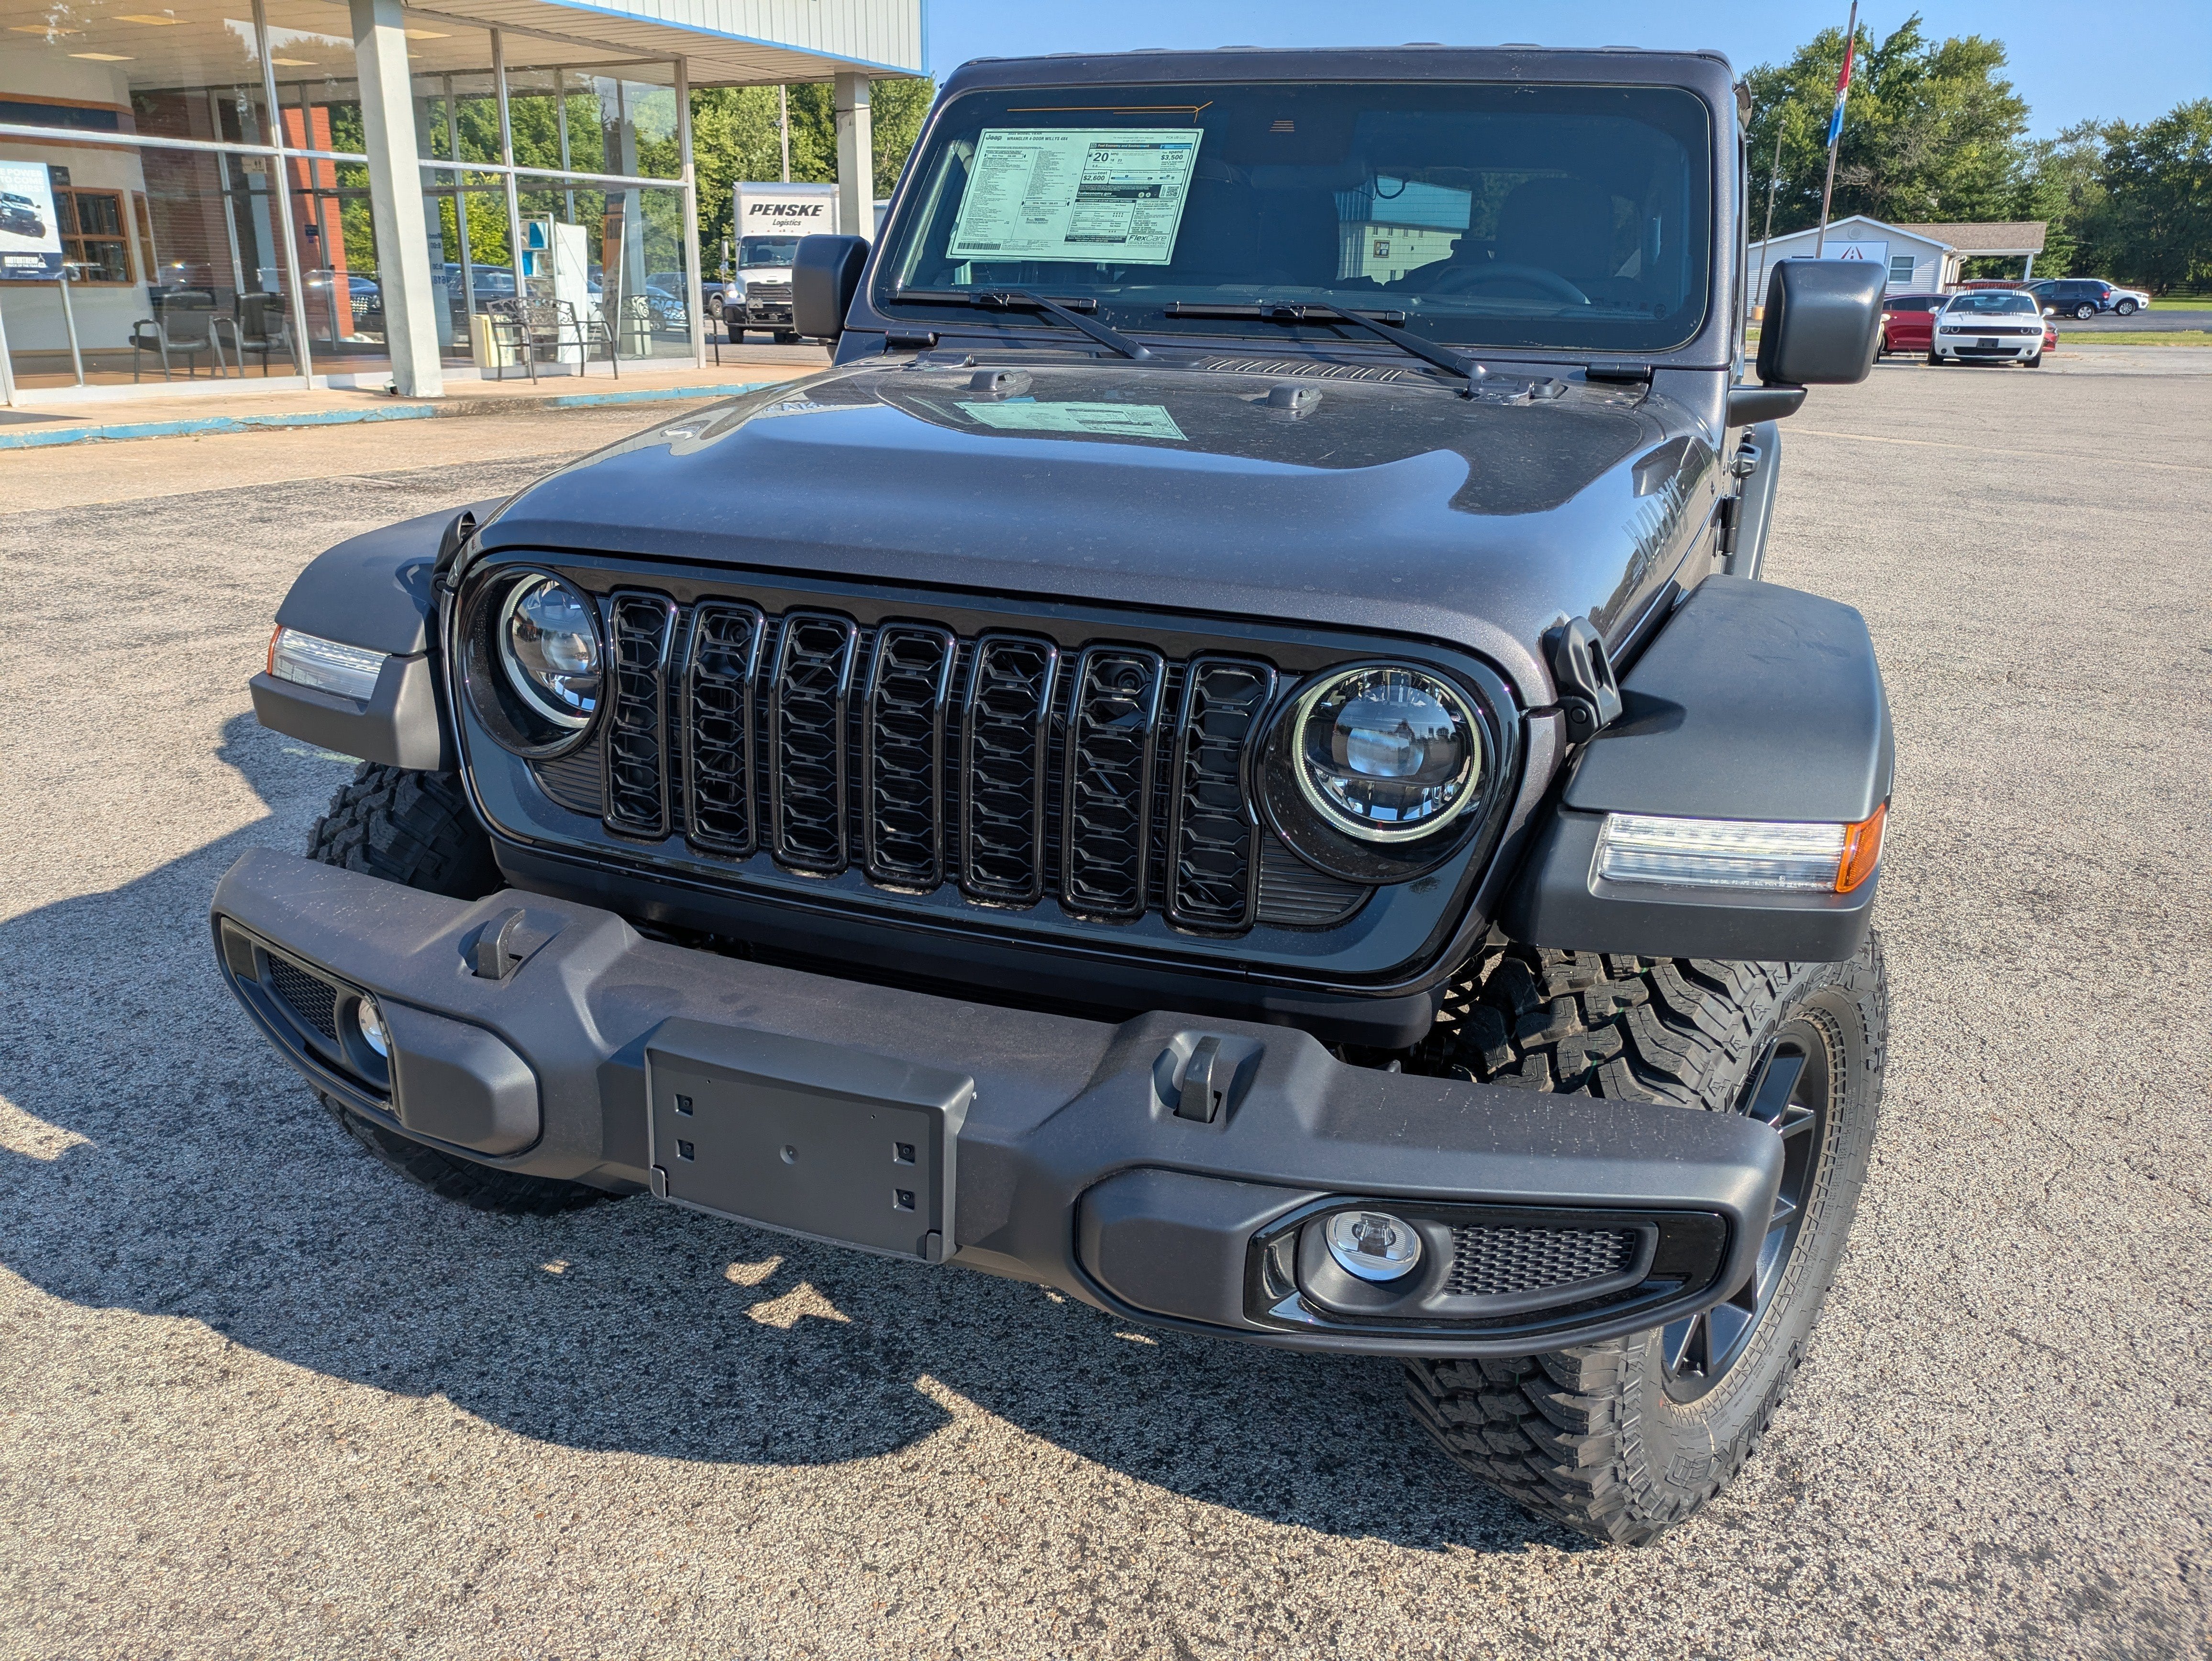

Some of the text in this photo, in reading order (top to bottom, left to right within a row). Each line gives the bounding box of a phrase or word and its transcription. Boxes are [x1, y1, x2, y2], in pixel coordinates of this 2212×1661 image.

[1093, 152, 1109, 162] 20
[7, 169, 43, 177] POWER
[749, 204, 824, 216] PENSKE
[1789, 1244, 1817, 1307] STEEL BELTED RADIAL
